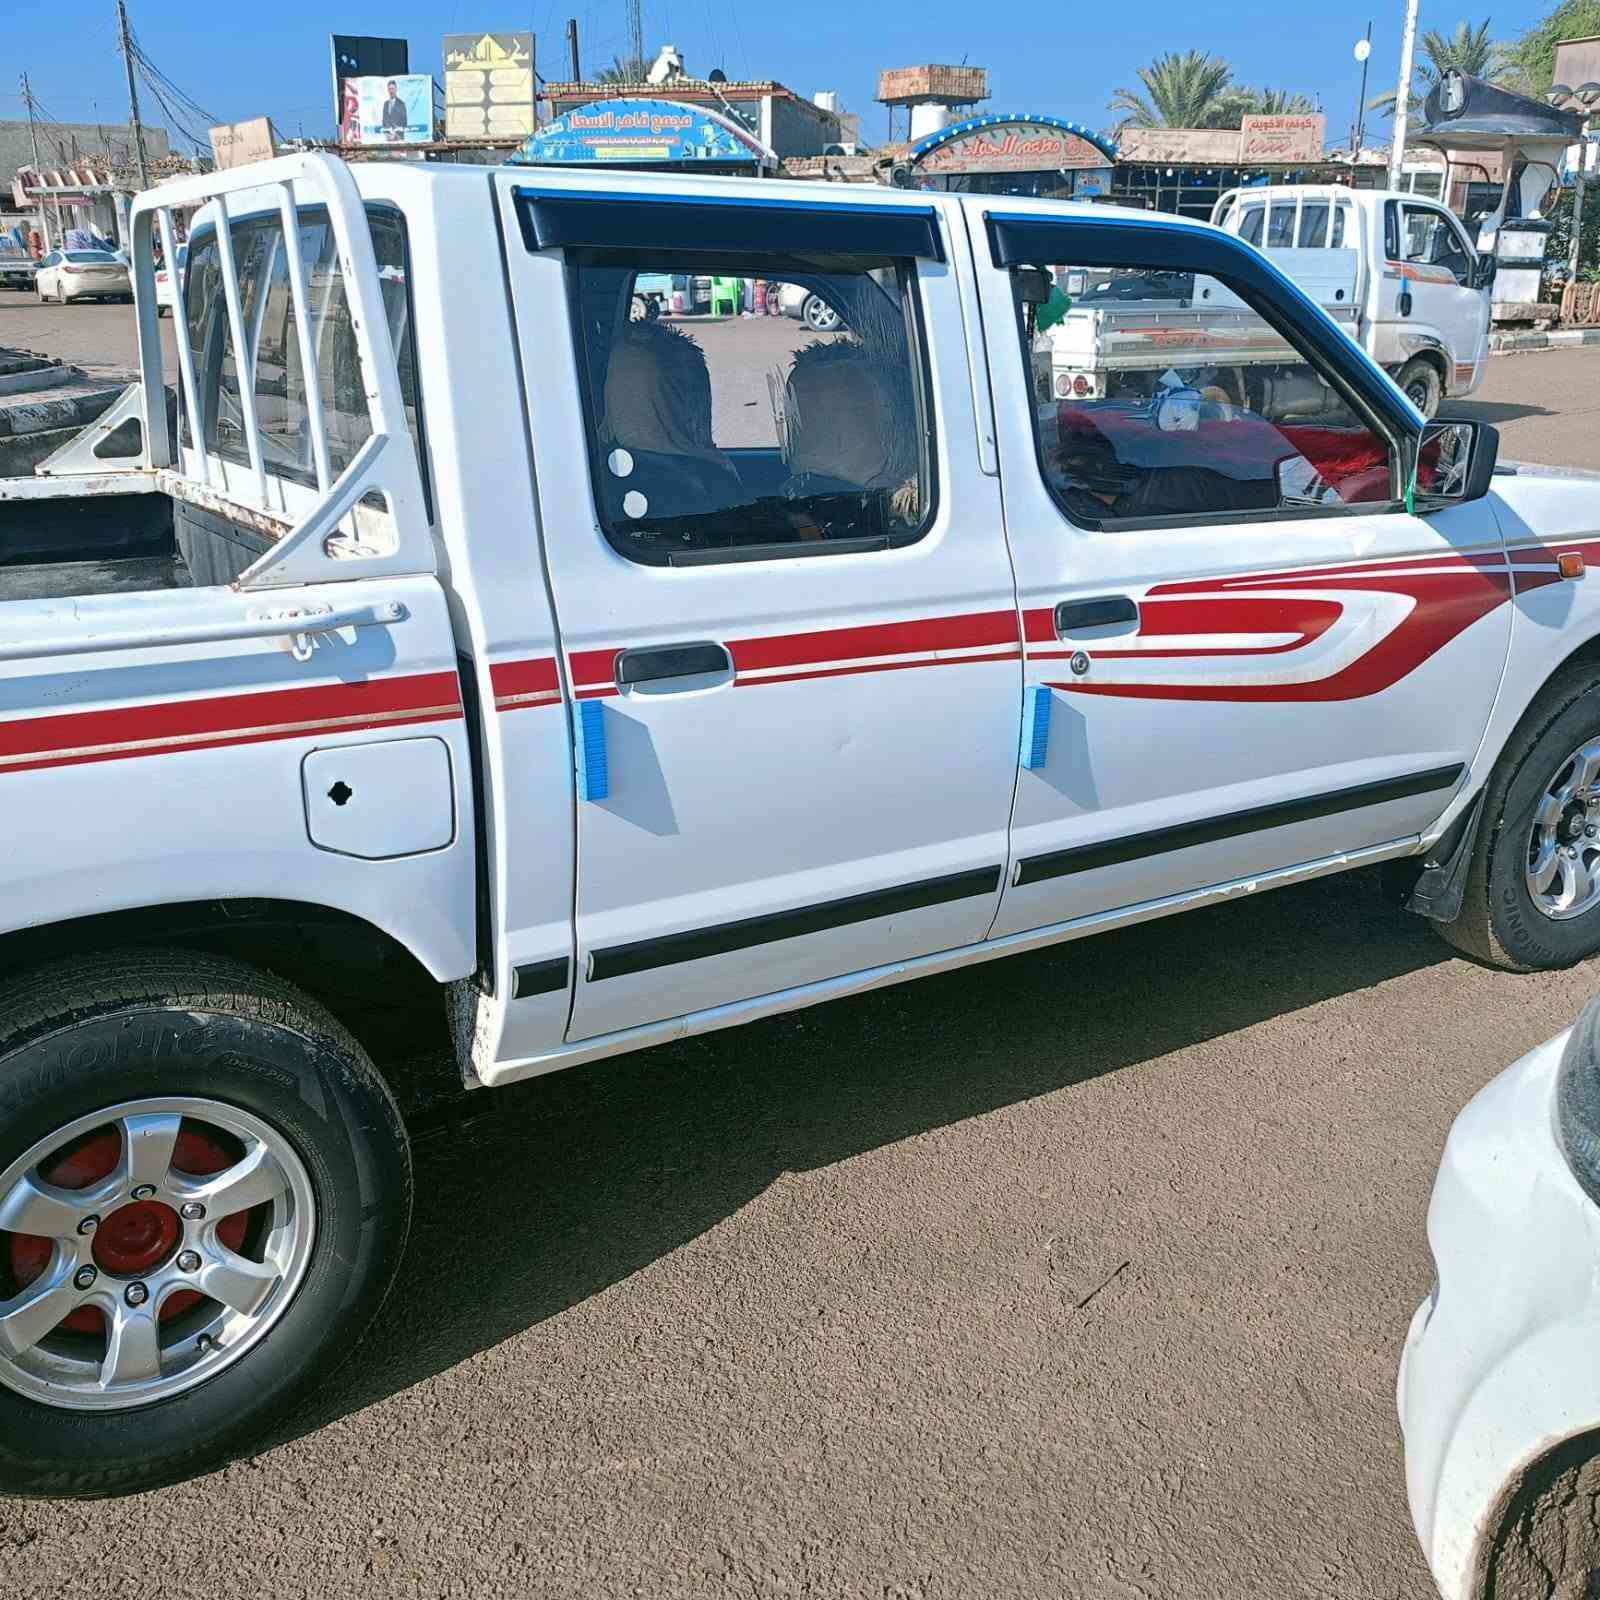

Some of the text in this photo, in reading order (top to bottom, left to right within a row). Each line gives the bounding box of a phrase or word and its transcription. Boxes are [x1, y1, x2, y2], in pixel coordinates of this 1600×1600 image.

[615, 111, 649, 133] قاهر
[652, 114, 692, 134] مجمع
[1017, 137, 1060, 154] مطعم
